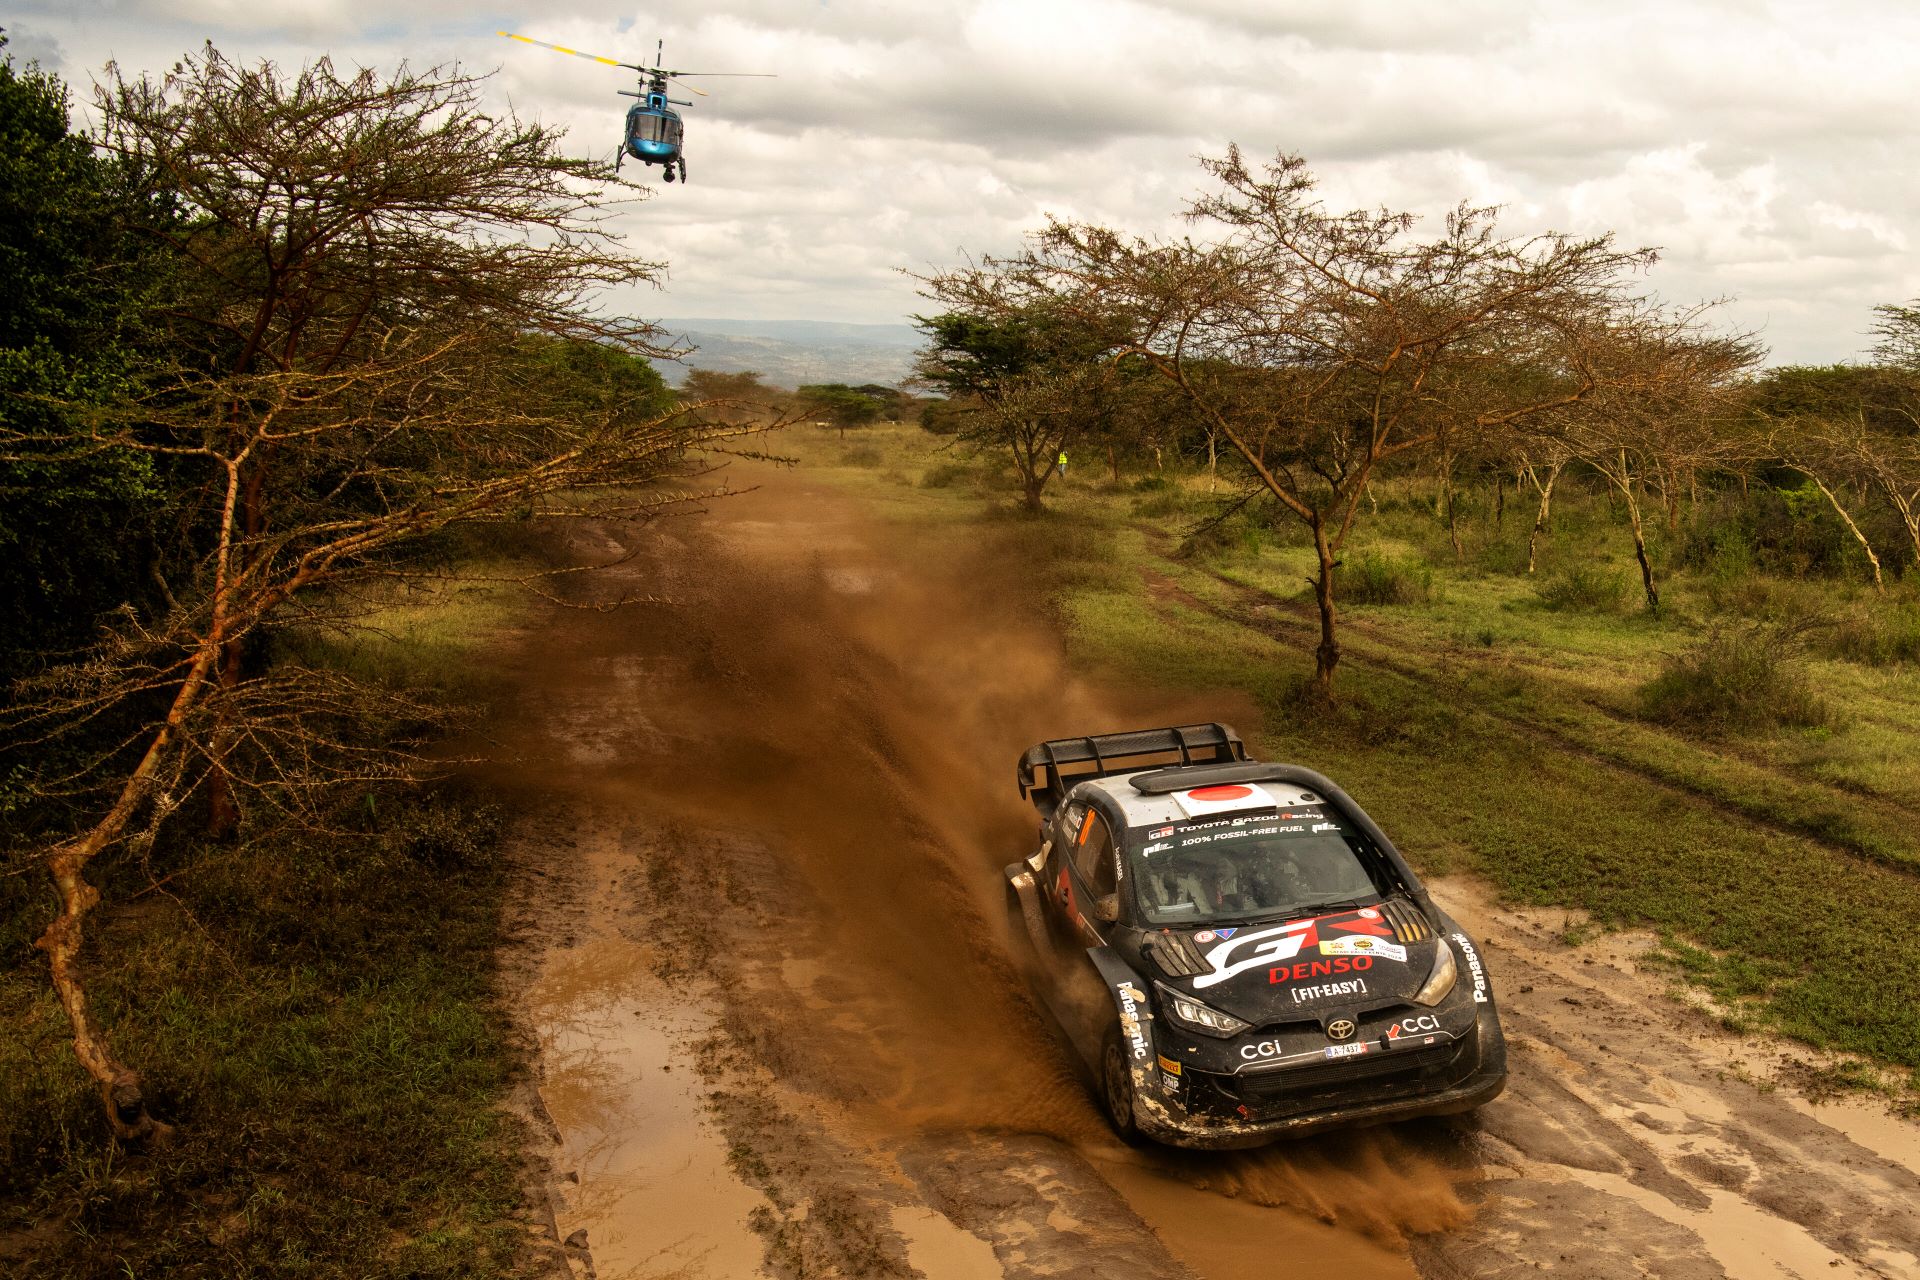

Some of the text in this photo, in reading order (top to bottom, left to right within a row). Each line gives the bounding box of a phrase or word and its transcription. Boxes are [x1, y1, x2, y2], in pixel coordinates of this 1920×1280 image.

[1177, 820, 1230, 833] TOYOTA
[1231, 815, 1279, 827] GAZOO
[1281, 809, 1324, 820] Racing
[1181, 835, 1212, 847] 100%
[1214, 827, 1278, 841] FOSSIL-FREE
[1280, 825, 1305, 833] FUEL
[1269, 955, 1373, 985] DENSO
[1452, 933, 1488, 1003] Panasonic
[1162, 1075, 1179, 1090] OMP
